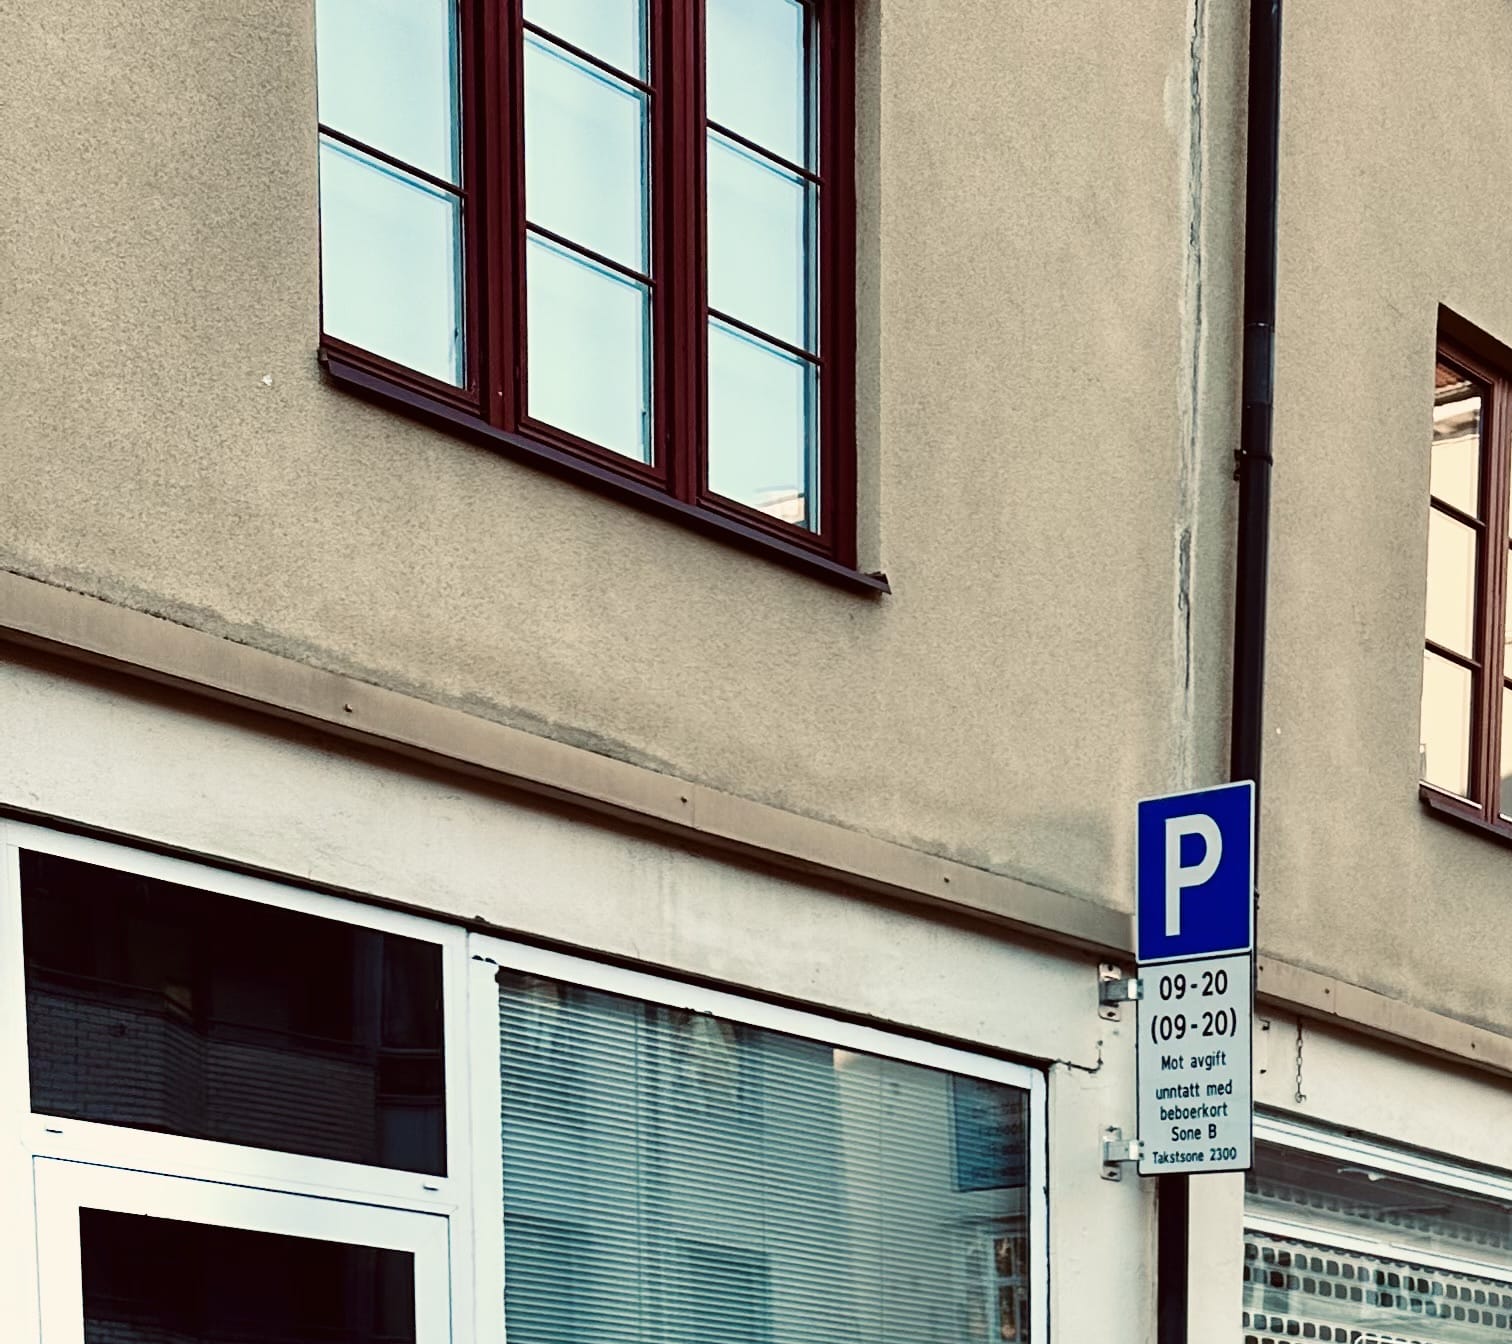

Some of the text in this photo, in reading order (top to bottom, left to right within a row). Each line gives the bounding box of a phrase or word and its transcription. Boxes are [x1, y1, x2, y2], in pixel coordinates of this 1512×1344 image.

[1165, 813, 1222, 937] P
[1160, 969, 1228, 1001] 09-20
[1151, 1007, 1237, 1044] (09-20)
[1161, 1050, 1226, 1071] Mot avgift
[1155, 1079, 1232, 1100] unntatt med
[1160, 1102, 1228, 1121] beboerkort
[1171, 1123, 1217, 1142] Sone B
[1152, 1147, 1237, 1164] Takstsone 2300
